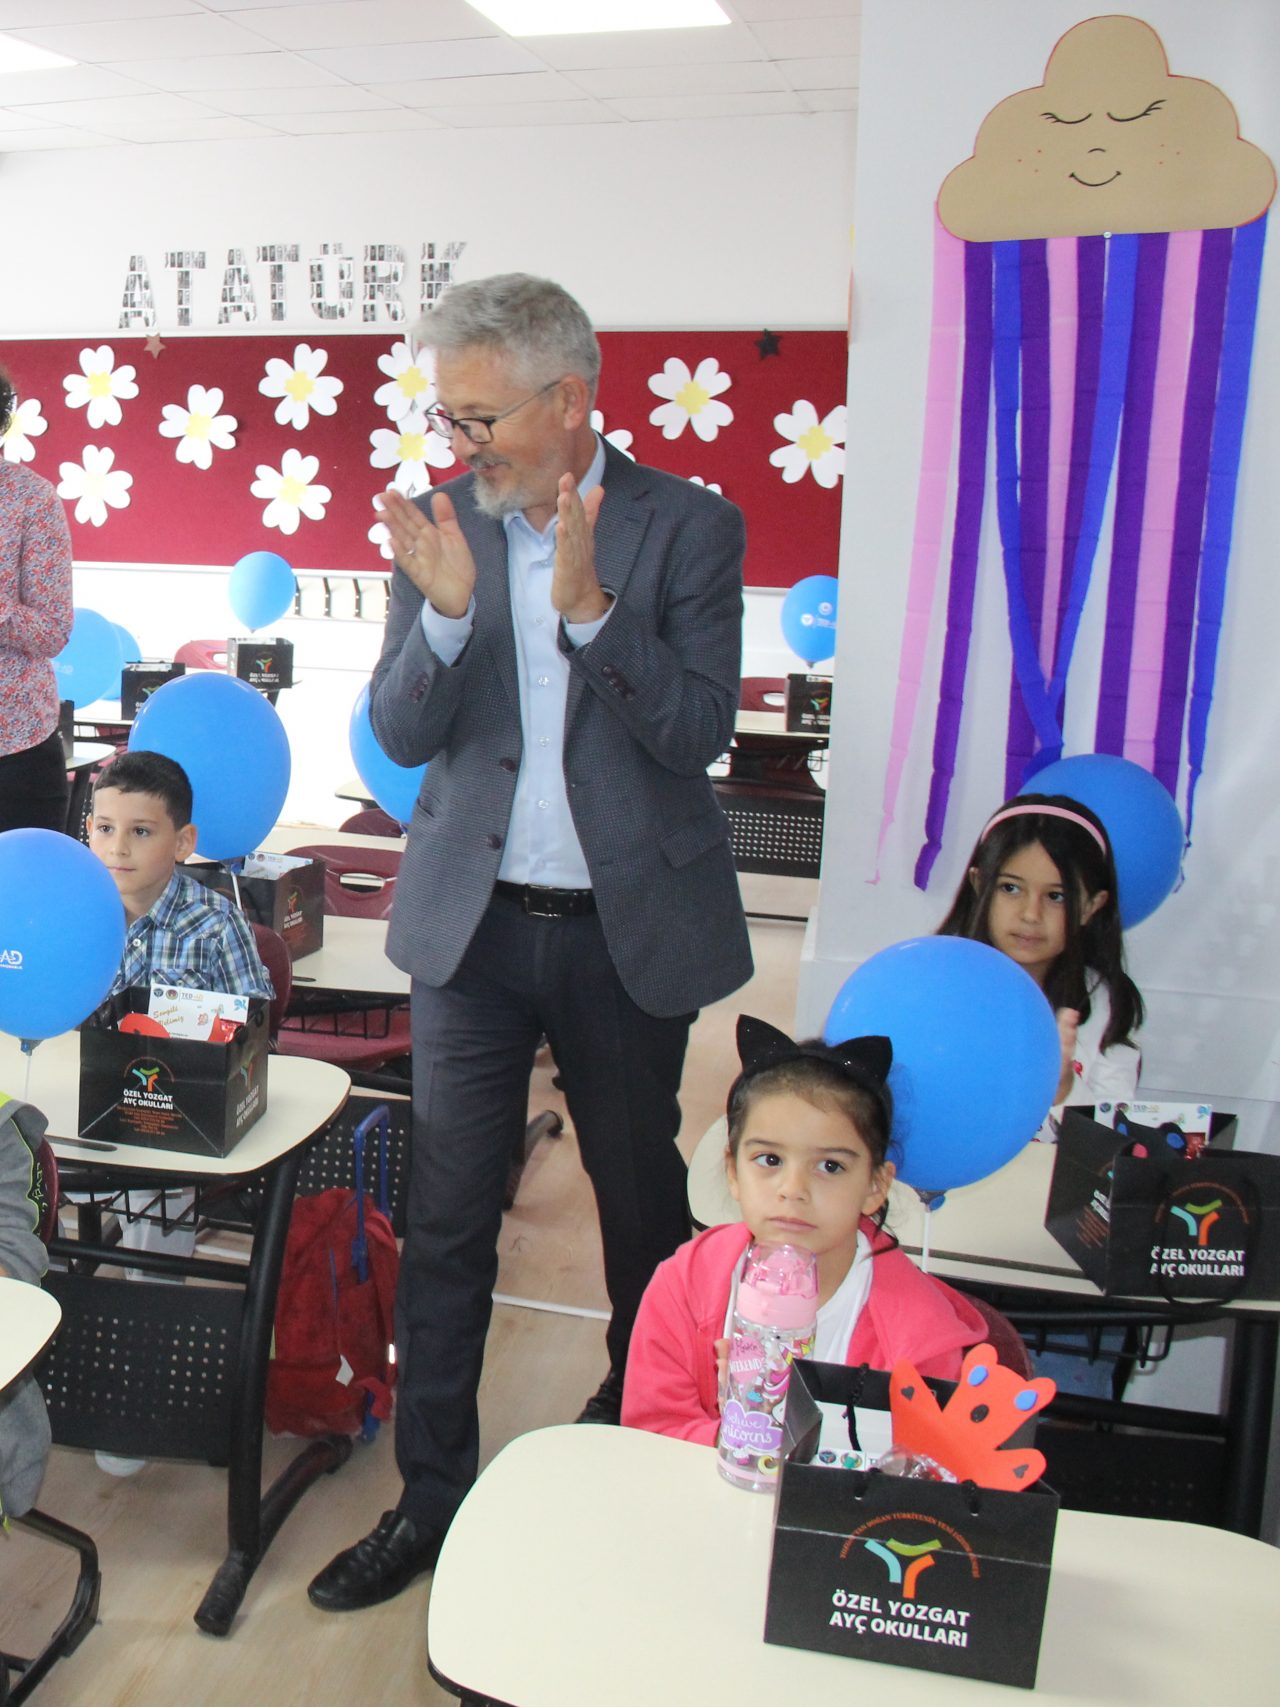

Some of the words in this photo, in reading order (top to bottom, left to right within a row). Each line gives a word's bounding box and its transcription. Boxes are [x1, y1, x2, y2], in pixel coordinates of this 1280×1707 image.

[118, 241, 468, 330] ATATÜRK
[123, 1088, 142, 1098] ÖZEL
[143, 1092, 173, 1102] YOZGAT
[123, 1097, 137, 1107] AYÇ
[138, 1100, 174, 1110] OKULLARI
[1151, 1246, 1186, 1260] ÖZEL
[1188, 1249, 1245, 1262] YOZGAT
[1150, 1262, 1177, 1278] AYÇ
[1178, 1263, 1245, 1277] OKULLARI
[831, 1588, 883, 1614] ÖZEL
[888, 1600, 971, 1627] YOZGAT
[829, 1610, 868, 1635] AYÇ
[870, 1618, 968, 1648] OKULLARI
